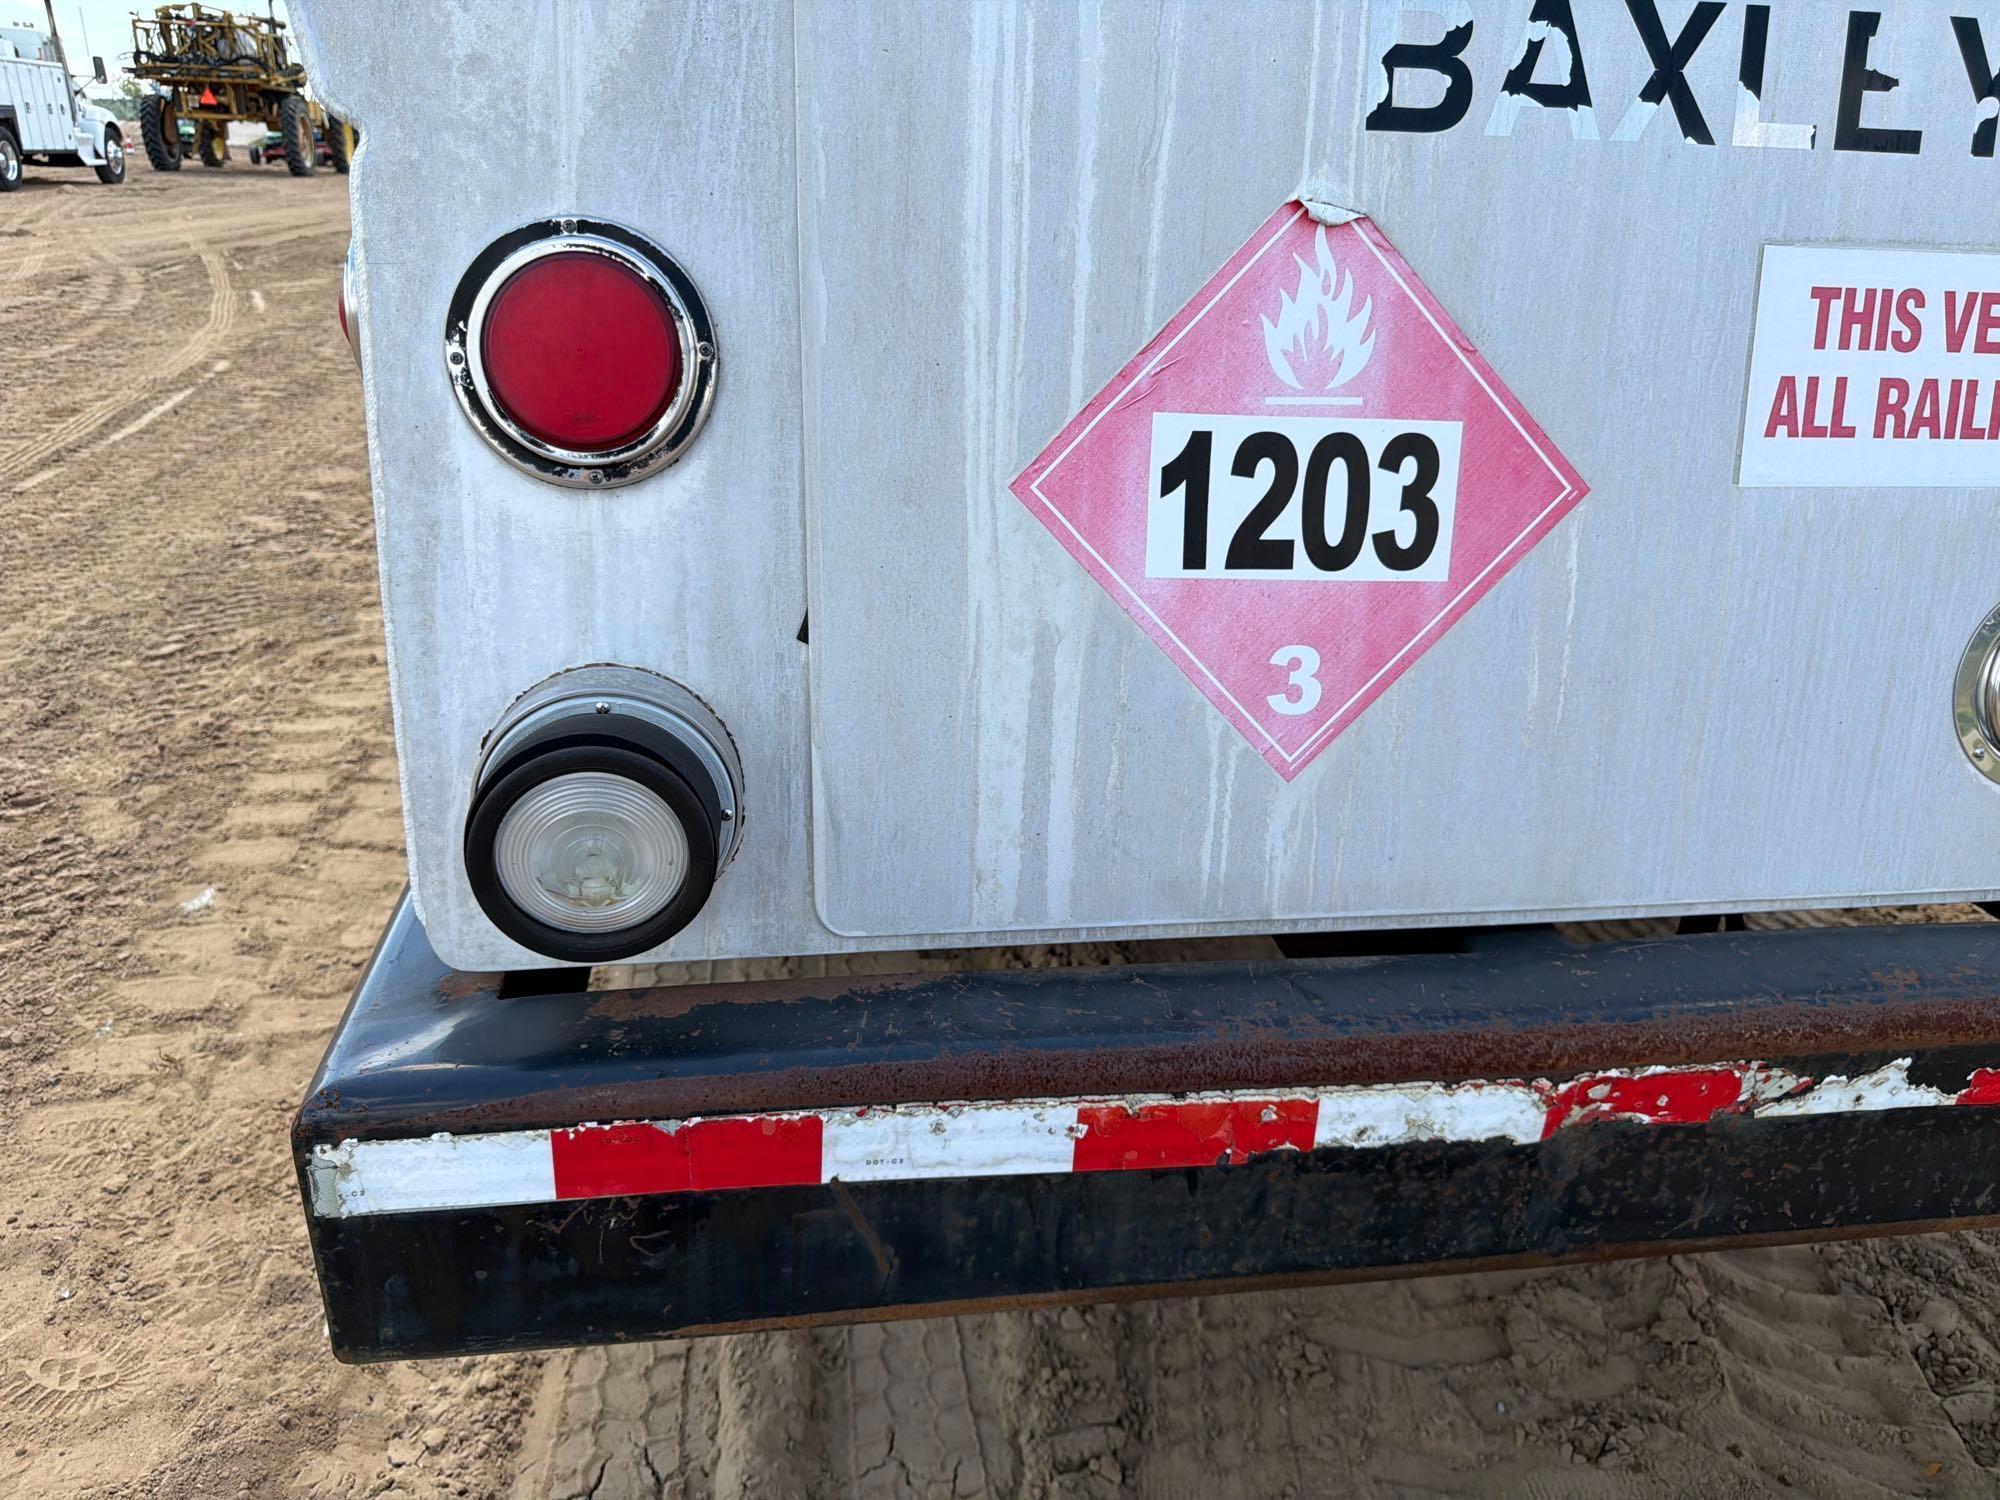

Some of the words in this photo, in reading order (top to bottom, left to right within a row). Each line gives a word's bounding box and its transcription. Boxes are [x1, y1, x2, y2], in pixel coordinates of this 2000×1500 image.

[1810, 286, 1926, 353] THIS
[1764, 376, 1857, 438] ALL
[1160, 430, 1441, 571] 1203
[1266, 645, 1322, 715] 3
